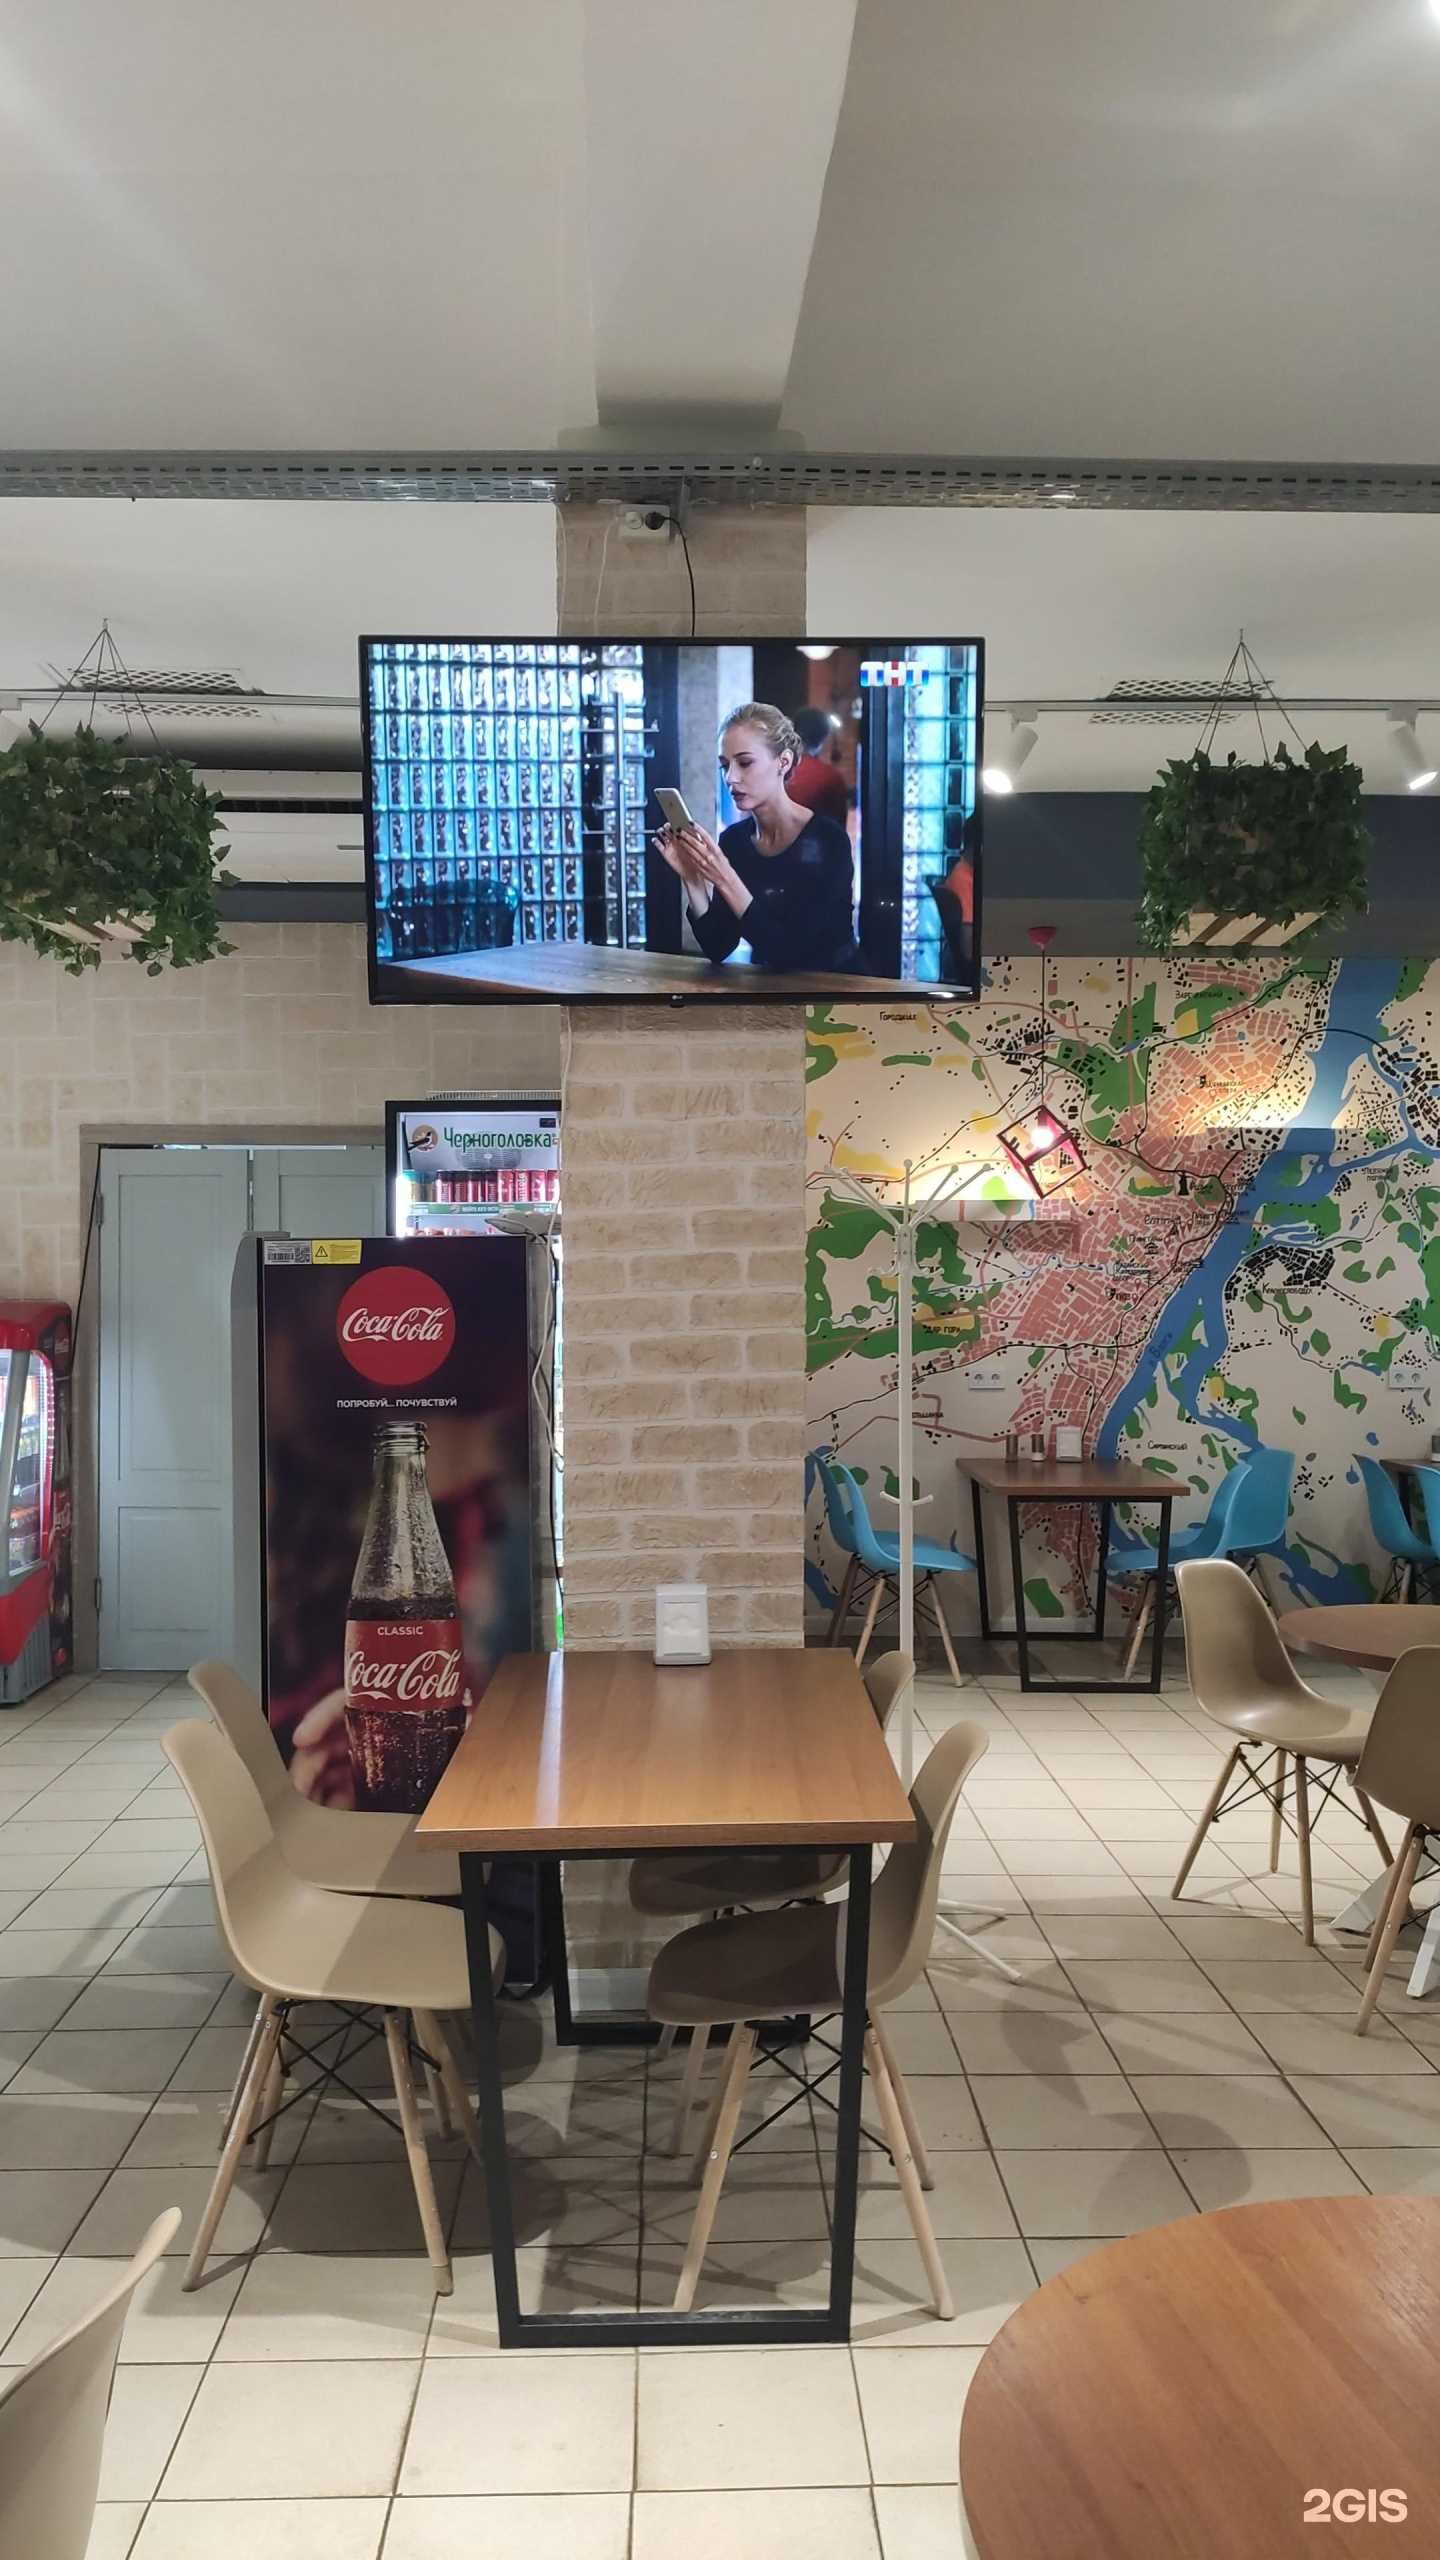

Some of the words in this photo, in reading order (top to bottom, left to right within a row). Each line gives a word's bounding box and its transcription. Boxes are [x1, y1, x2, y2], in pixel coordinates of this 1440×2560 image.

[860, 661, 929, 688] ТНТ
[443, 1126, 552, 1152] Черноголовка
[342, 1306, 449, 1342] Coca-Cola
[396, 1396, 457, 1407] ПОЧУВСТВУЙ
[377, 1625, 424, 1636] CLASSIC
